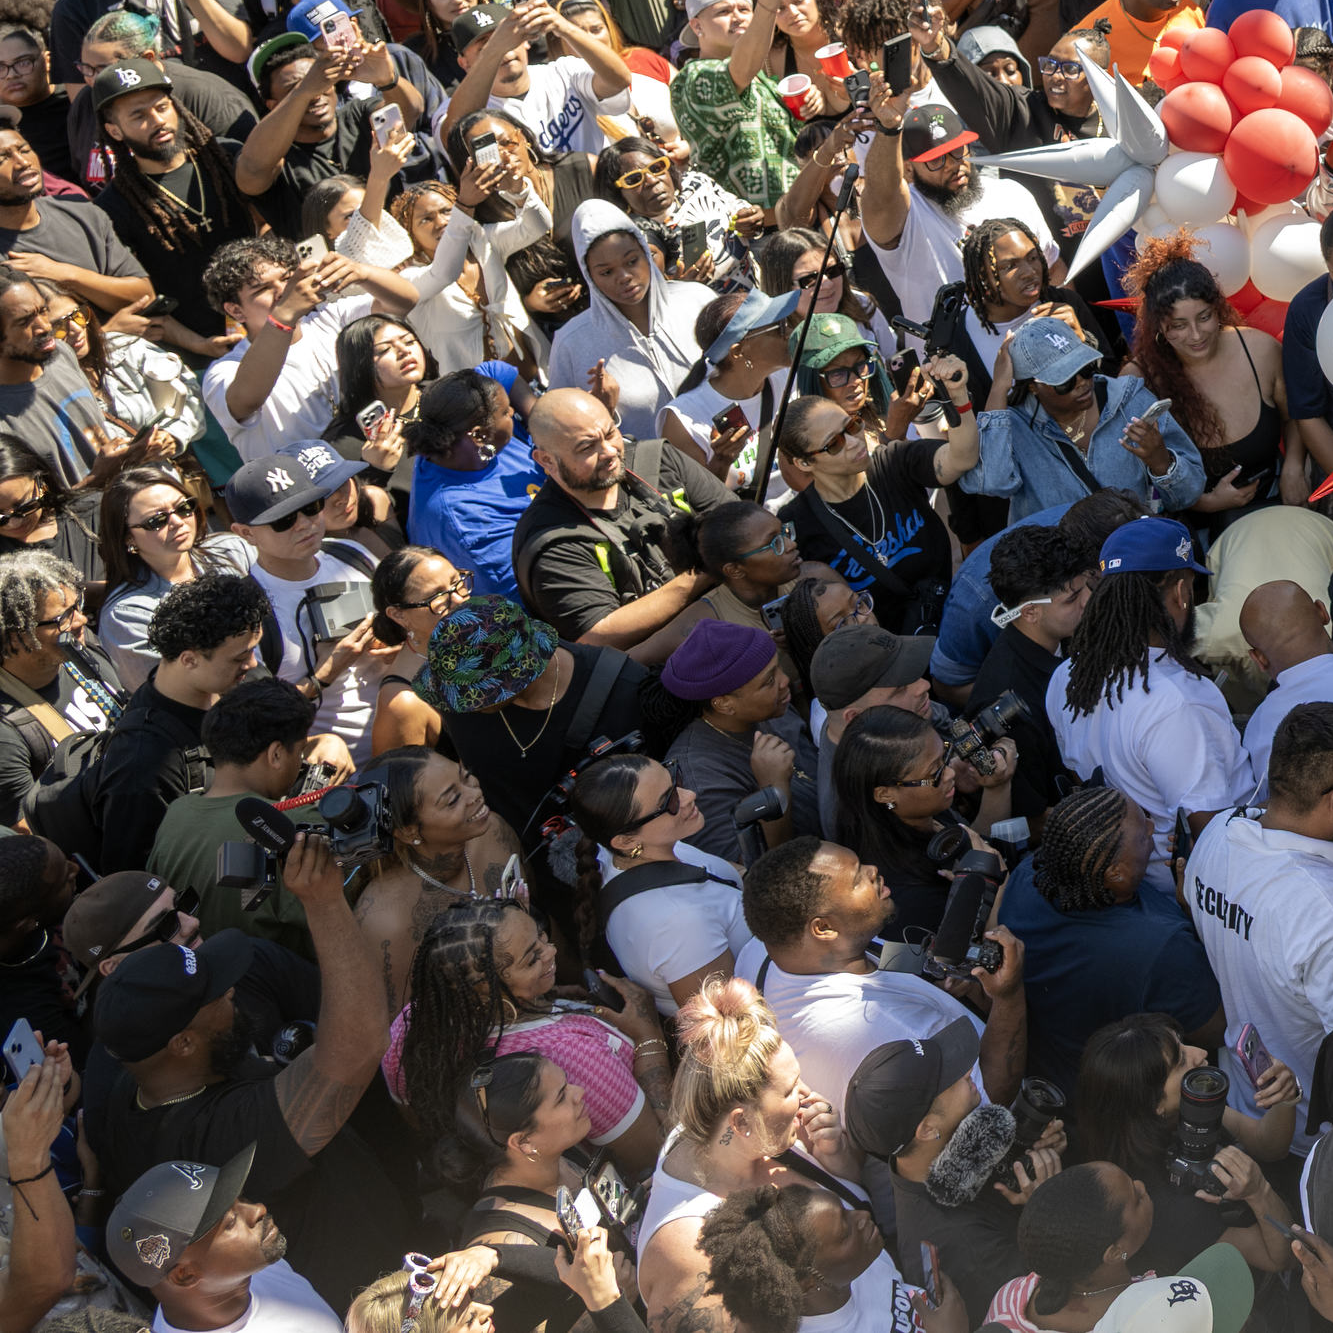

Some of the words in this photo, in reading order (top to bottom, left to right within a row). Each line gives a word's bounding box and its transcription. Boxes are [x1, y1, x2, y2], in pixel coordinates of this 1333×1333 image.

[471, 9, 495, 28] LA
[538, 95, 582, 153] dgers
[1044, 333, 1070, 350] LA
[265, 466, 296, 494] NY
[1194, 875, 1254, 941] SECURITY
